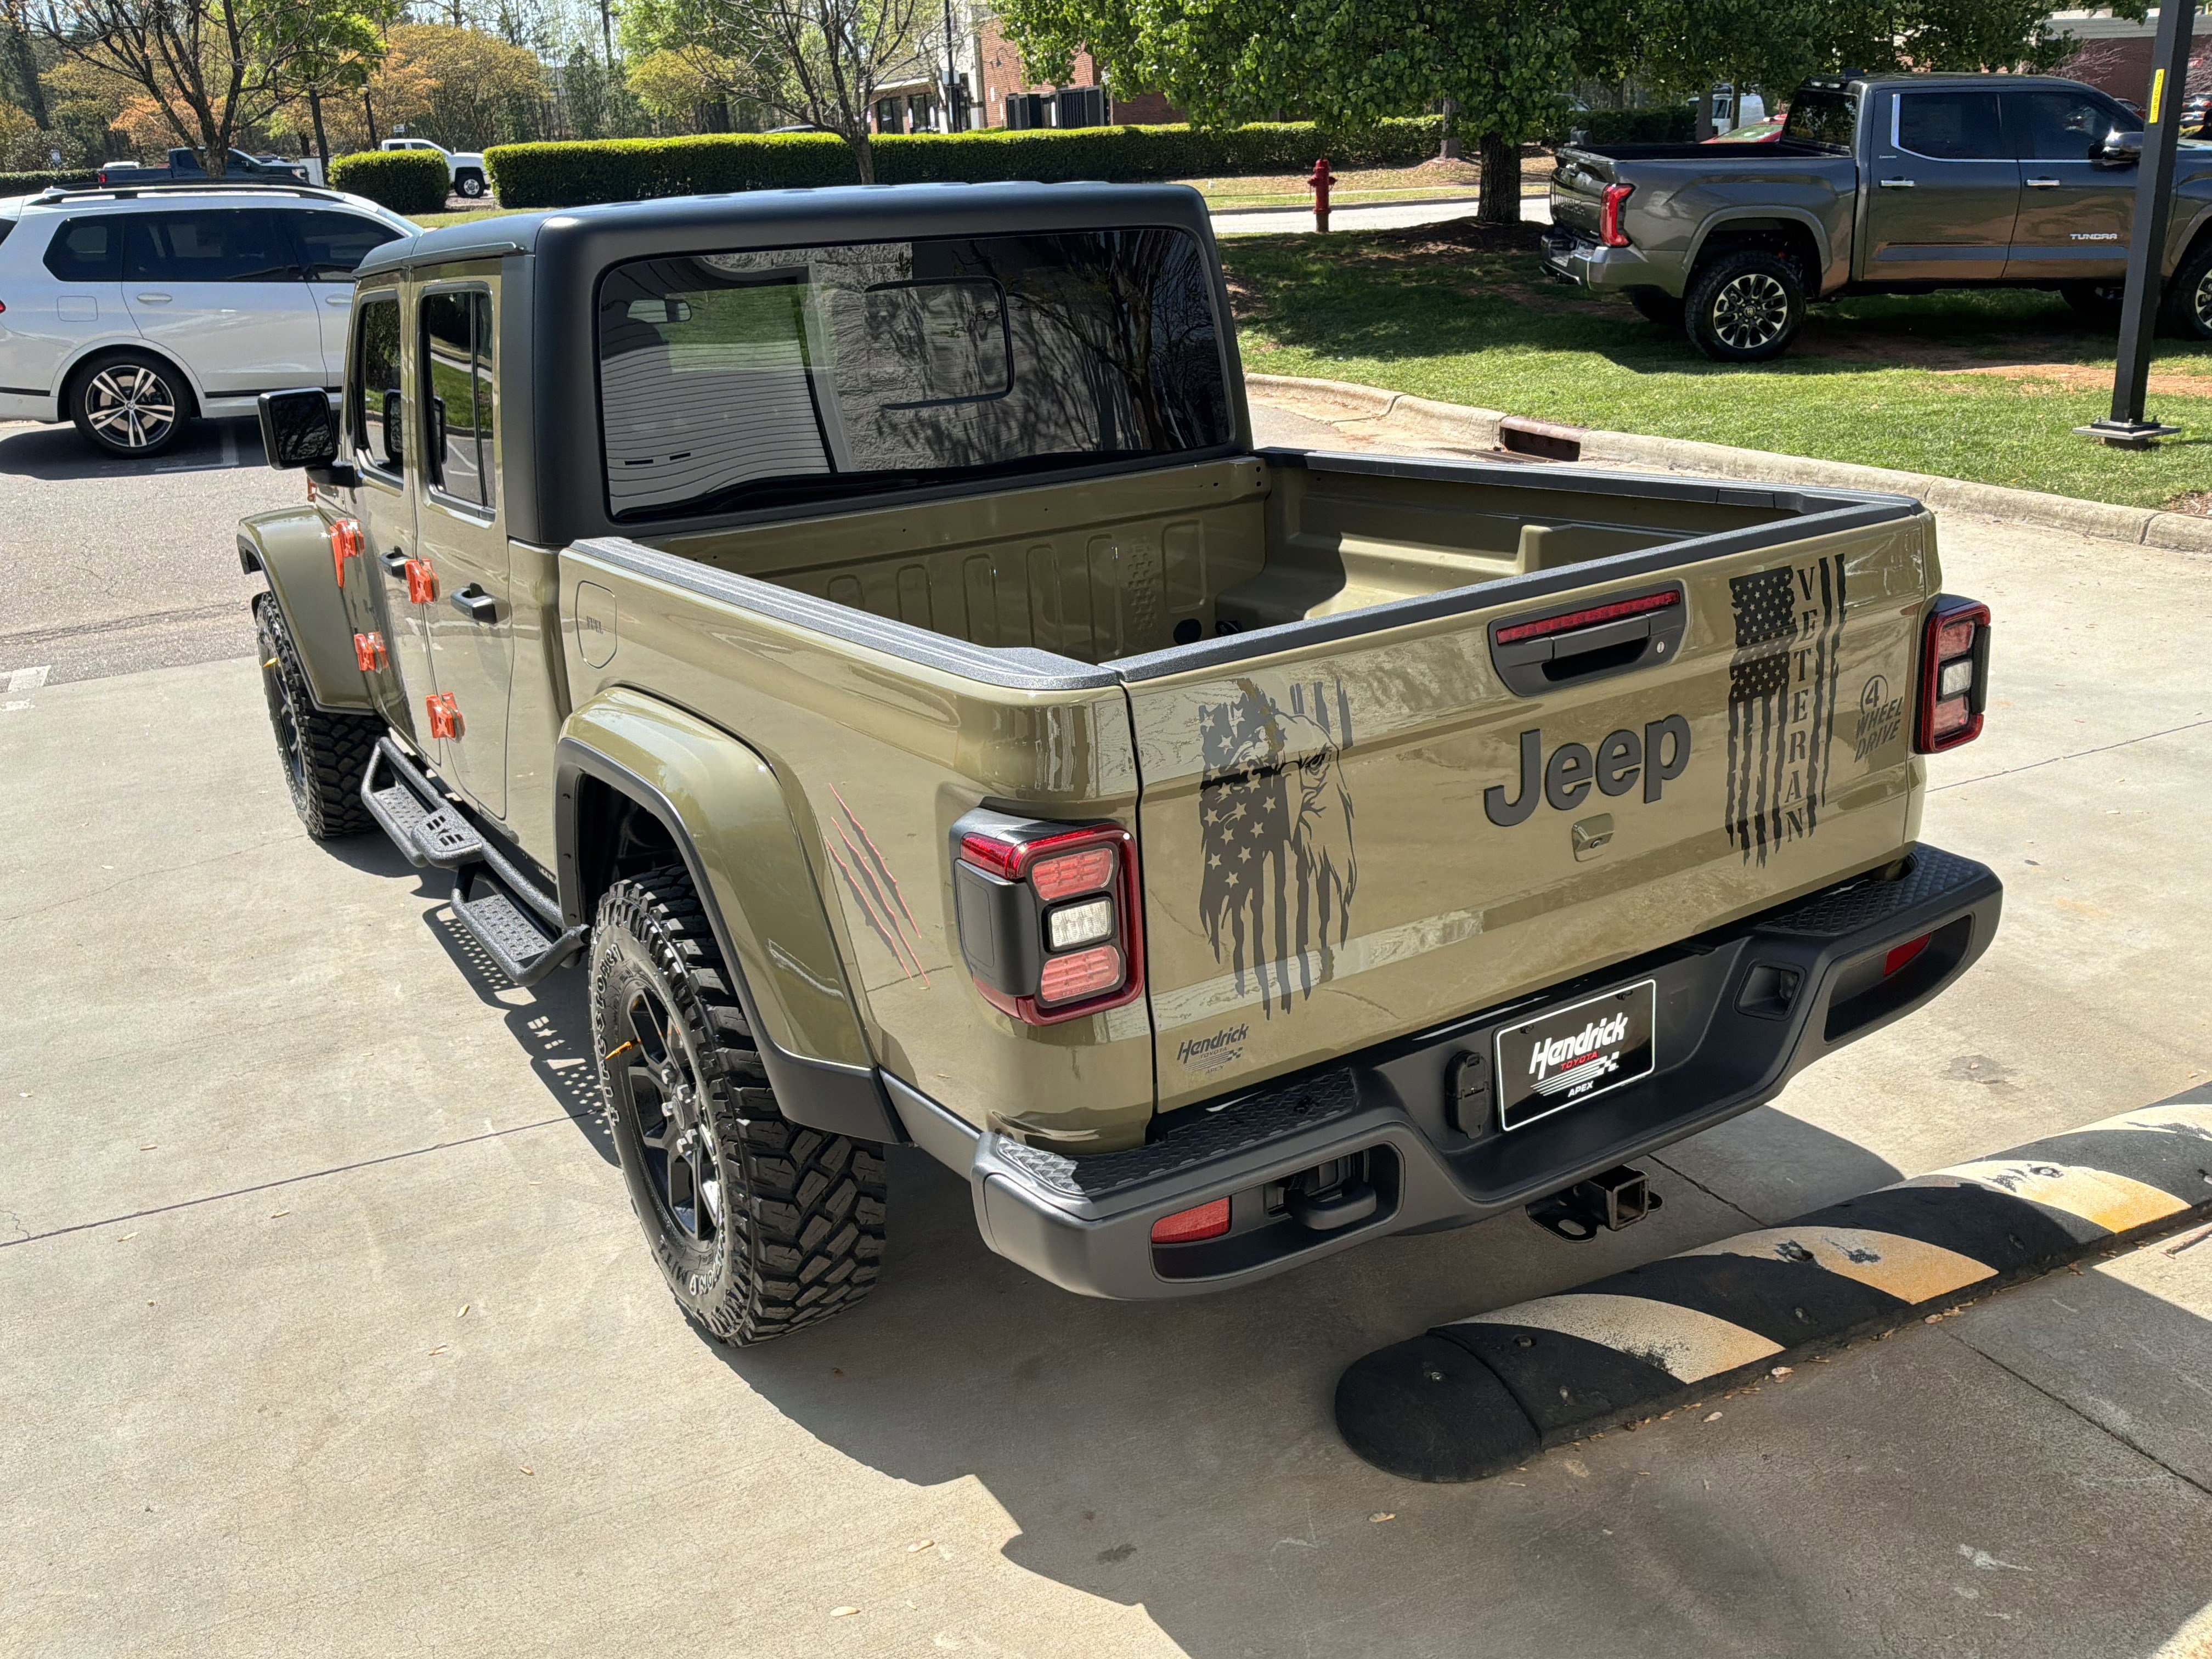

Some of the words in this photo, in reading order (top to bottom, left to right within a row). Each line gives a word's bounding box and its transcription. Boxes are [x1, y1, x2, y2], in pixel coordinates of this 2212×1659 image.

[1785, 566, 1818, 843] VETERAN
[1865, 679, 1880, 708] 4
[1857, 696, 1904, 739] WHEEL
[1854, 719, 1901, 763] DRIVE
[1484, 714, 1691, 827] Jeep
[1176, 1023, 1249, 1064] Hendrick
[1200, 1047, 1227, 1059] TOYOTA
[1528, 1012, 1628, 1075] Hendrick
[1561, 1049, 1598, 1070] TOYOTA
[1567, 1080, 1594, 1097] APEX
